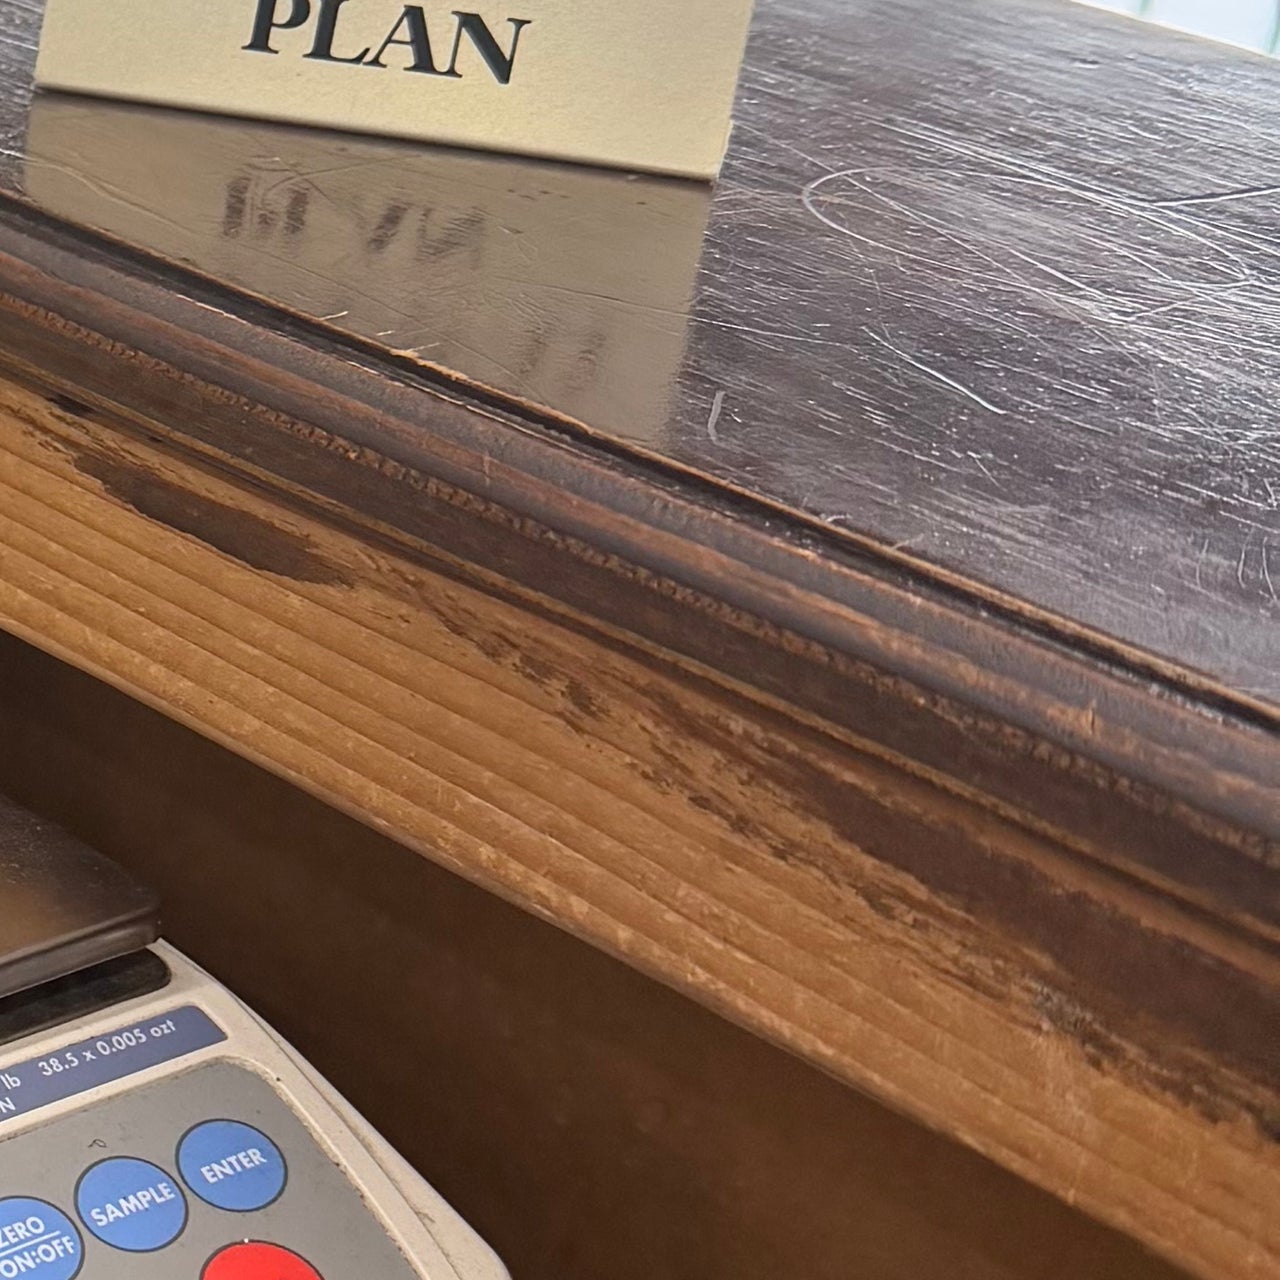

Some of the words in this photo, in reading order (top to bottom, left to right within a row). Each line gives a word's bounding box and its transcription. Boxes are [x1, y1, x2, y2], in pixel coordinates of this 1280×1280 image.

[0, 1072, 22, 1090] lb
[38, 1051, 80, 1077] 38.5
[82, 1048, 97, 1062] x
[96, 1029, 147, 1056] 0.005
[150, 1020, 176, 1038] ozt
[200, 1148, 267, 1184] ENTER
[90, 1181, 176, 1228] SAMPLE
